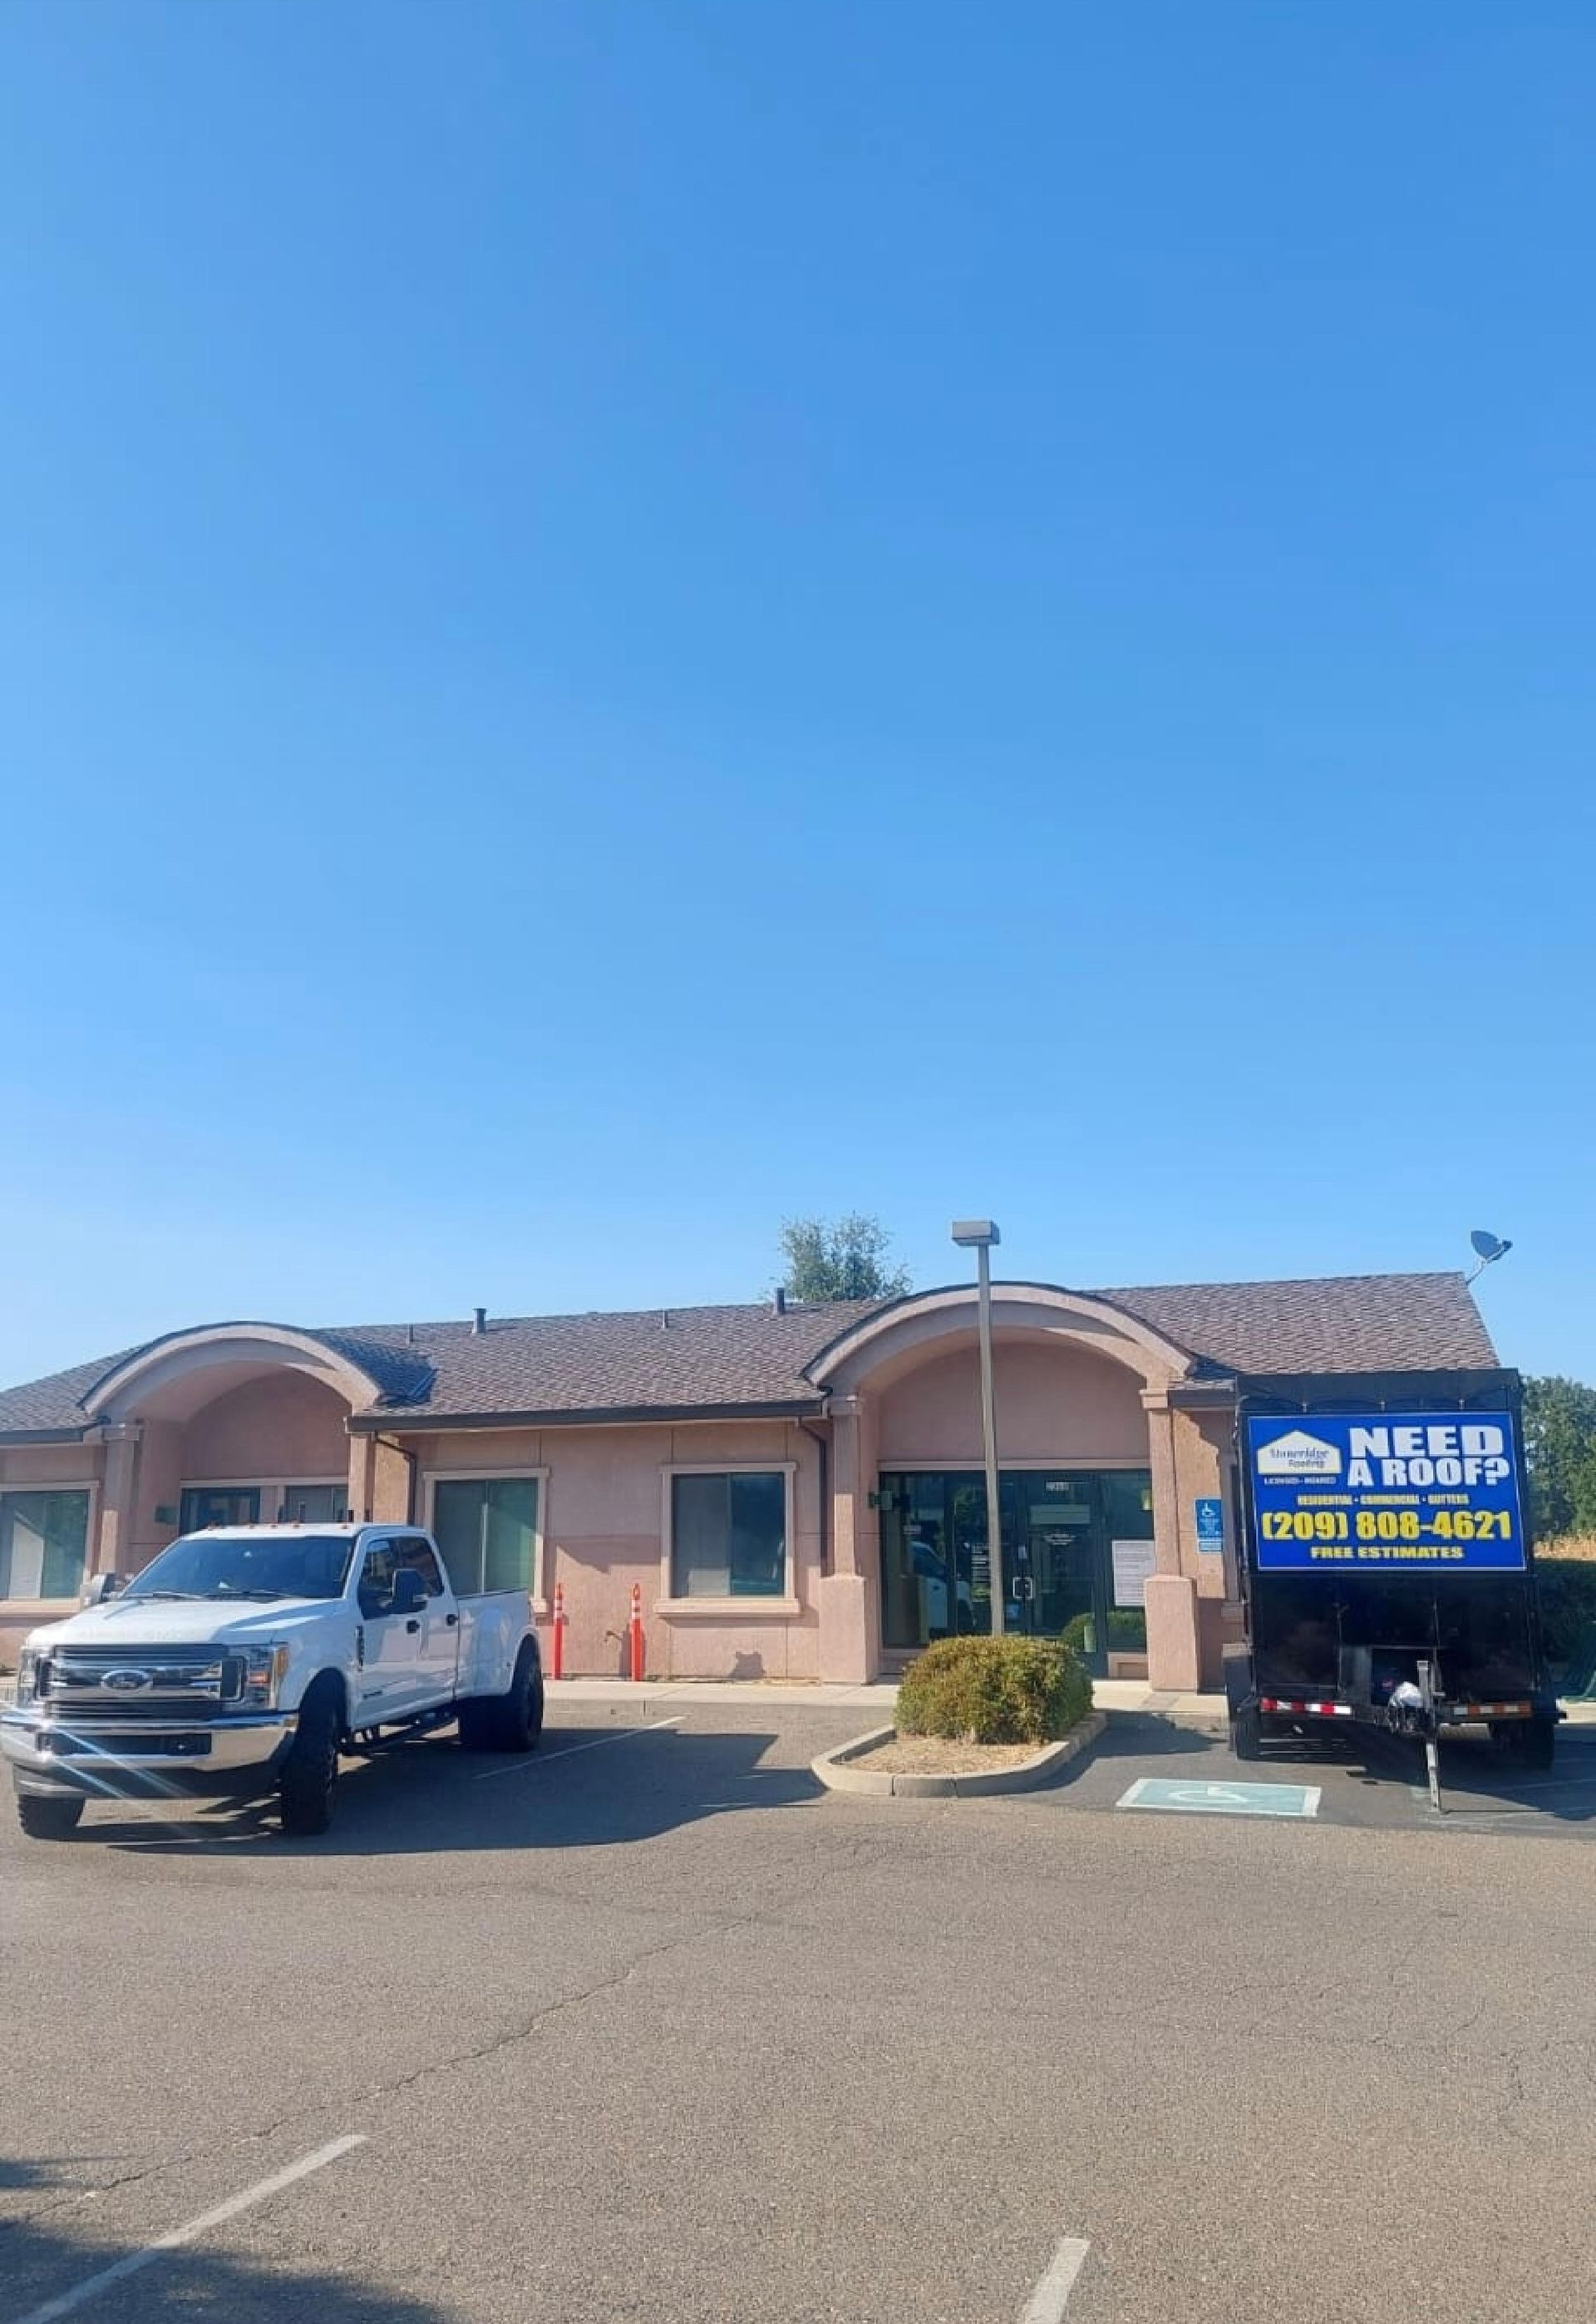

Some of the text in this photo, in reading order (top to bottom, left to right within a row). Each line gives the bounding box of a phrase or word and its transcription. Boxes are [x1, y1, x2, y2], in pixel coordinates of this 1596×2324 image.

[1349, 1426, 1504, 1457] NEED
[1347, 1458, 1510, 1486] A ROOF?
[1262, 1511, 1511, 1540] (209) 808-4621
[1311, 1547, 1464, 1559] FREE ESTIMATES
